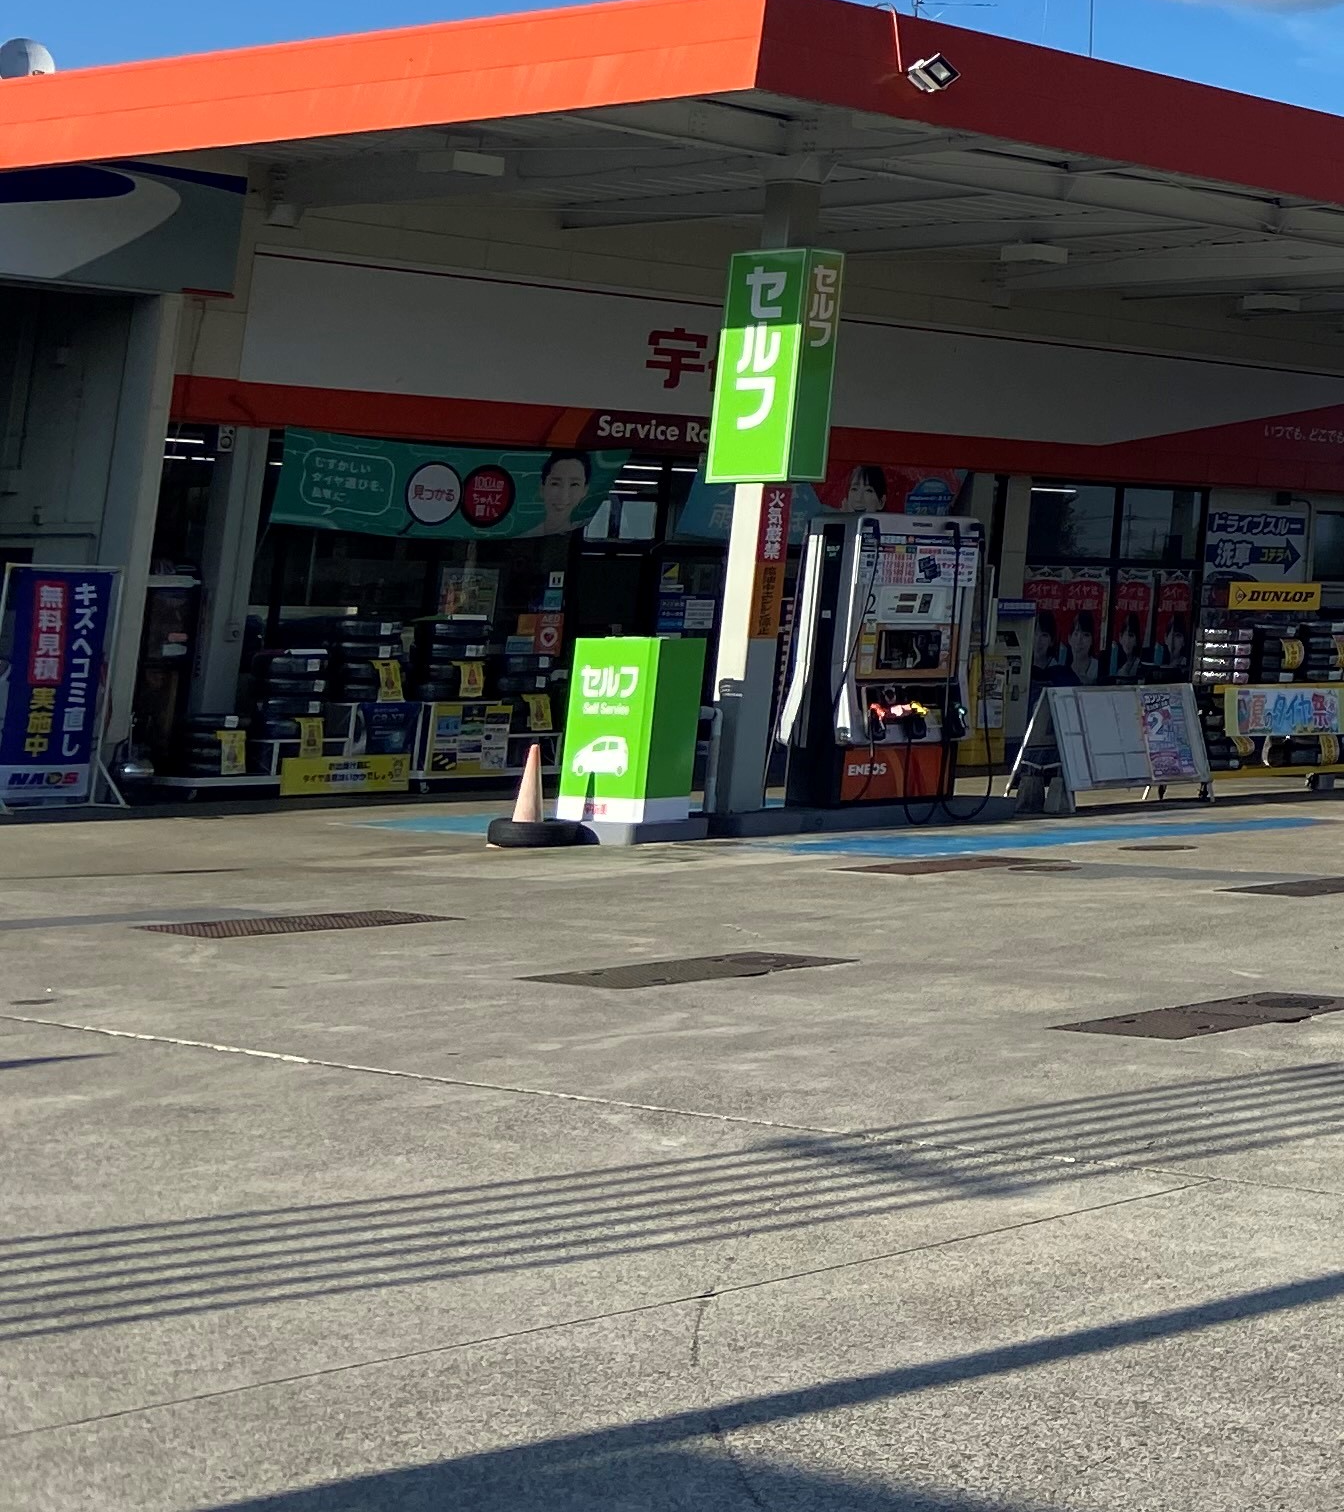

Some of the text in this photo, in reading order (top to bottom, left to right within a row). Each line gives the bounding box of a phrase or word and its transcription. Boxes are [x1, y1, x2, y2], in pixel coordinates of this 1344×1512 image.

[810, 265, 837, 347] セルフ
[646, 328, 713, 391] 宇
[735, 266, 787, 430] セルフ
[597, 416, 679, 440] Service
[413, 485, 455, 502] 見つかる
[763, 490, 785, 560] 火気厳禁
[1212, 513, 1304, 534] ドライブスルー
[1215, 540, 1252, 567] 洗車
[1248, 591, 1314, 602] DUNLOP
[24, 585, 63, 757] 無料見積実施中
[62, 583, 98, 757] キズ・ヘコミ直し
[581, 664, 639, 698] セルフ
[847, 763, 887, 776] ENEOS
